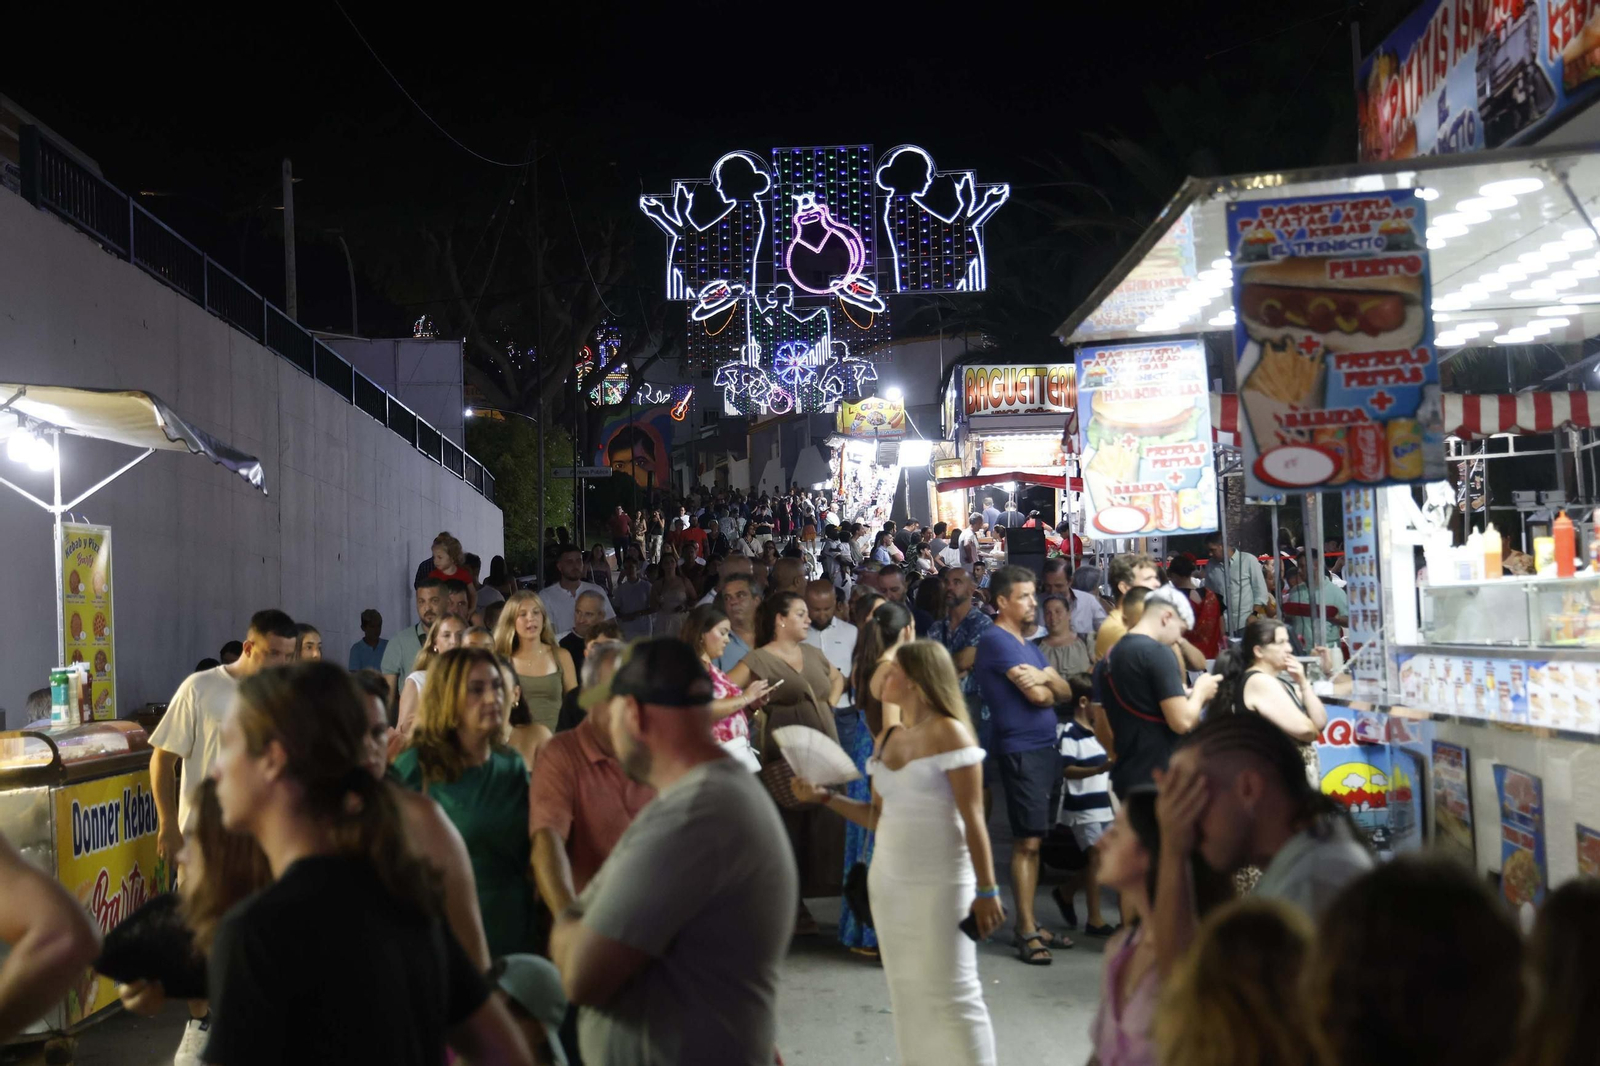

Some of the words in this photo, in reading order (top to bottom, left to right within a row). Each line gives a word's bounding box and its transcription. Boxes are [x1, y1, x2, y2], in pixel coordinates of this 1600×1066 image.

[1239, 214, 1329, 231] PATATAS
[1342, 207, 1415, 223] ASADAS
[1308, 223, 1372, 238] KEBAB
[1335, 348, 1430, 370] PATATAS
[1344, 366, 1424, 387] FRITAS
[1285, 408, 1369, 427] BEBIDA
[88, 537, 100, 553] Pizz
[72, 799, 121, 857] Donner
